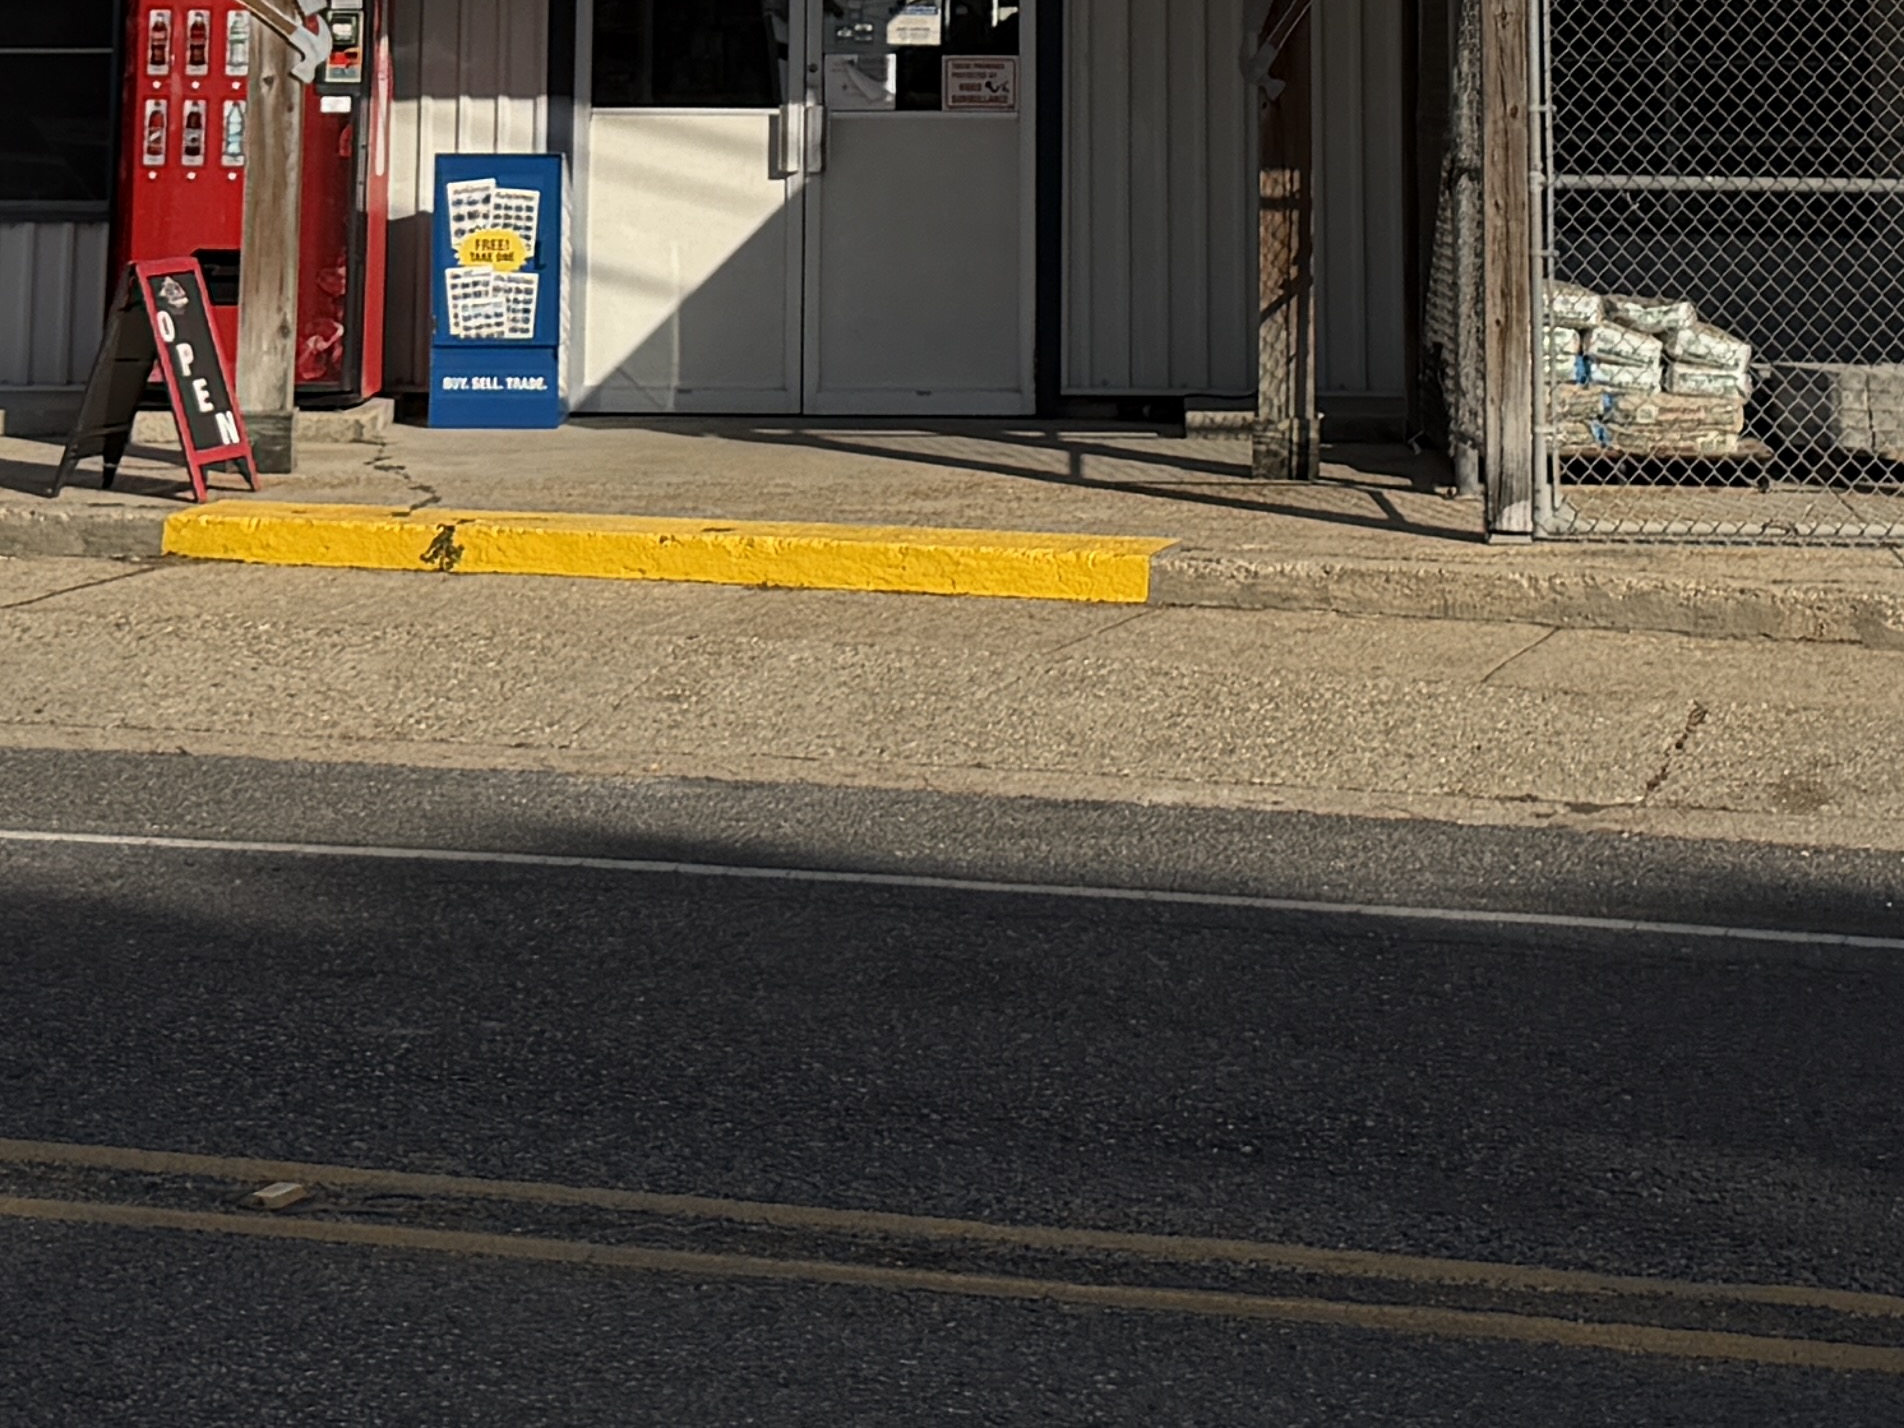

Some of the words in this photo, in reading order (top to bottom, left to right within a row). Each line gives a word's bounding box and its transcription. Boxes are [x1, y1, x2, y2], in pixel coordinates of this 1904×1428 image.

[475, 239, 510, 251] FREE!
[470, 252, 493, 262] TAKE
[496, 252, 514, 262] ONE
[157, 310, 240, 445] OPEN
